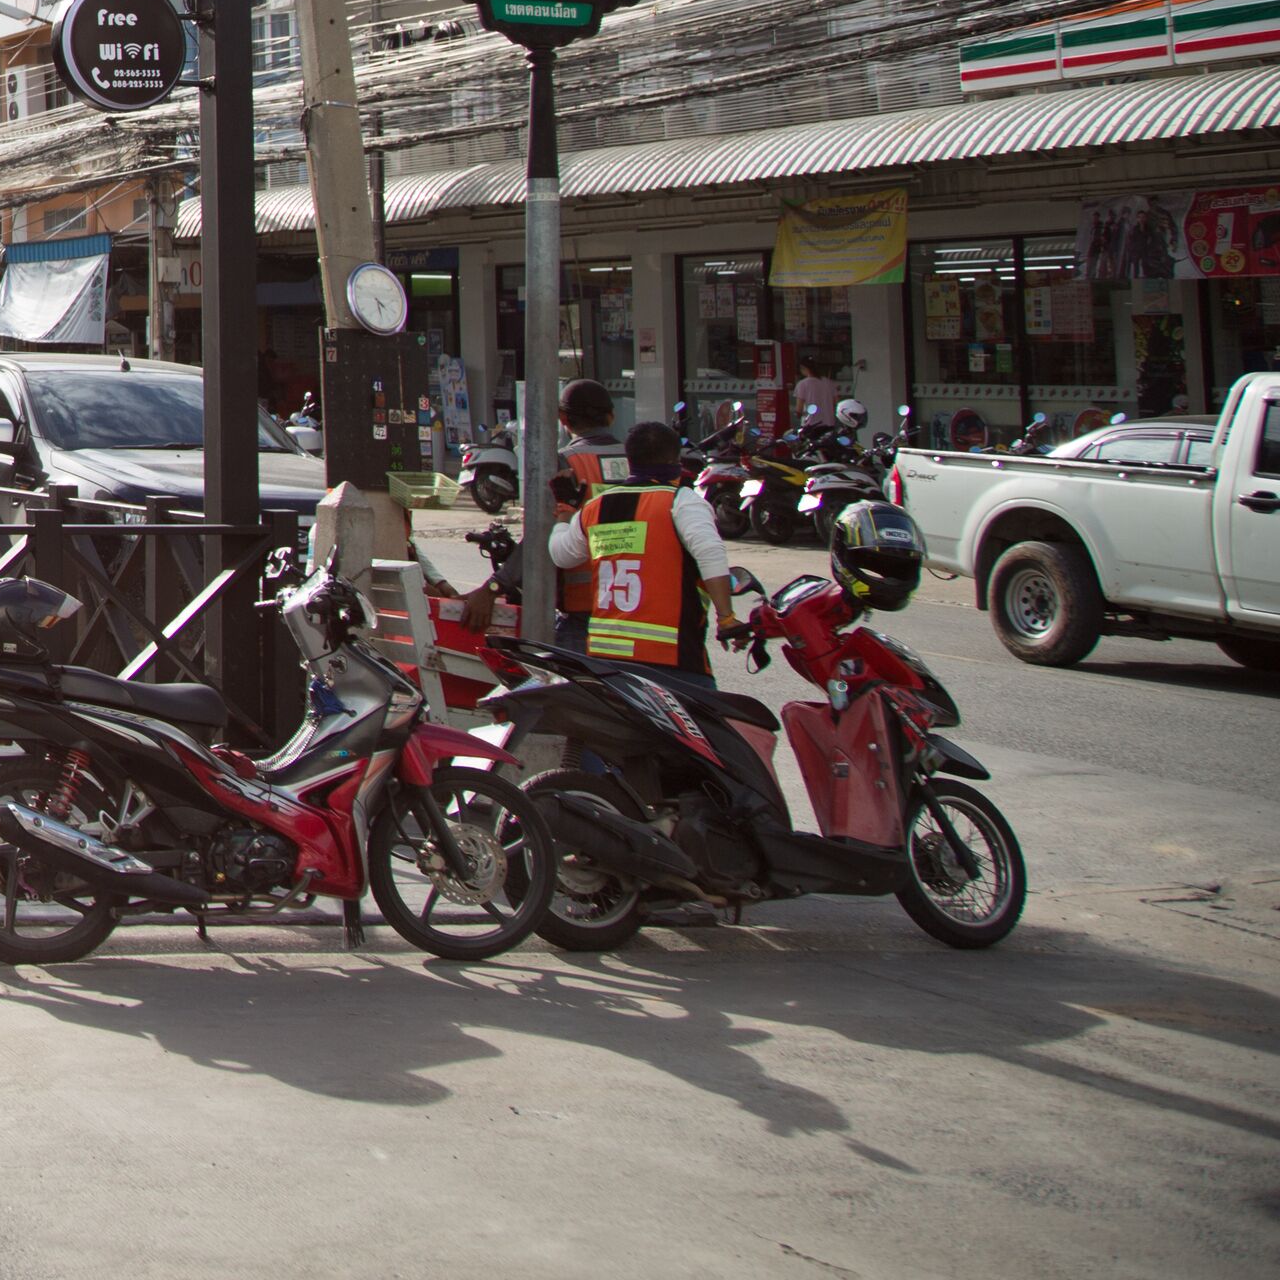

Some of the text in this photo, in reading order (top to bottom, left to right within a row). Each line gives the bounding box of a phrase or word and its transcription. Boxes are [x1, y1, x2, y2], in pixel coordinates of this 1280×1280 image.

[97, 9, 138, 26] Free
[505, 3, 577, 19] เขตดอนเมือง
[112, 80, 163, 88] 088-223-3333
[328, 349, 335, 360] 7
